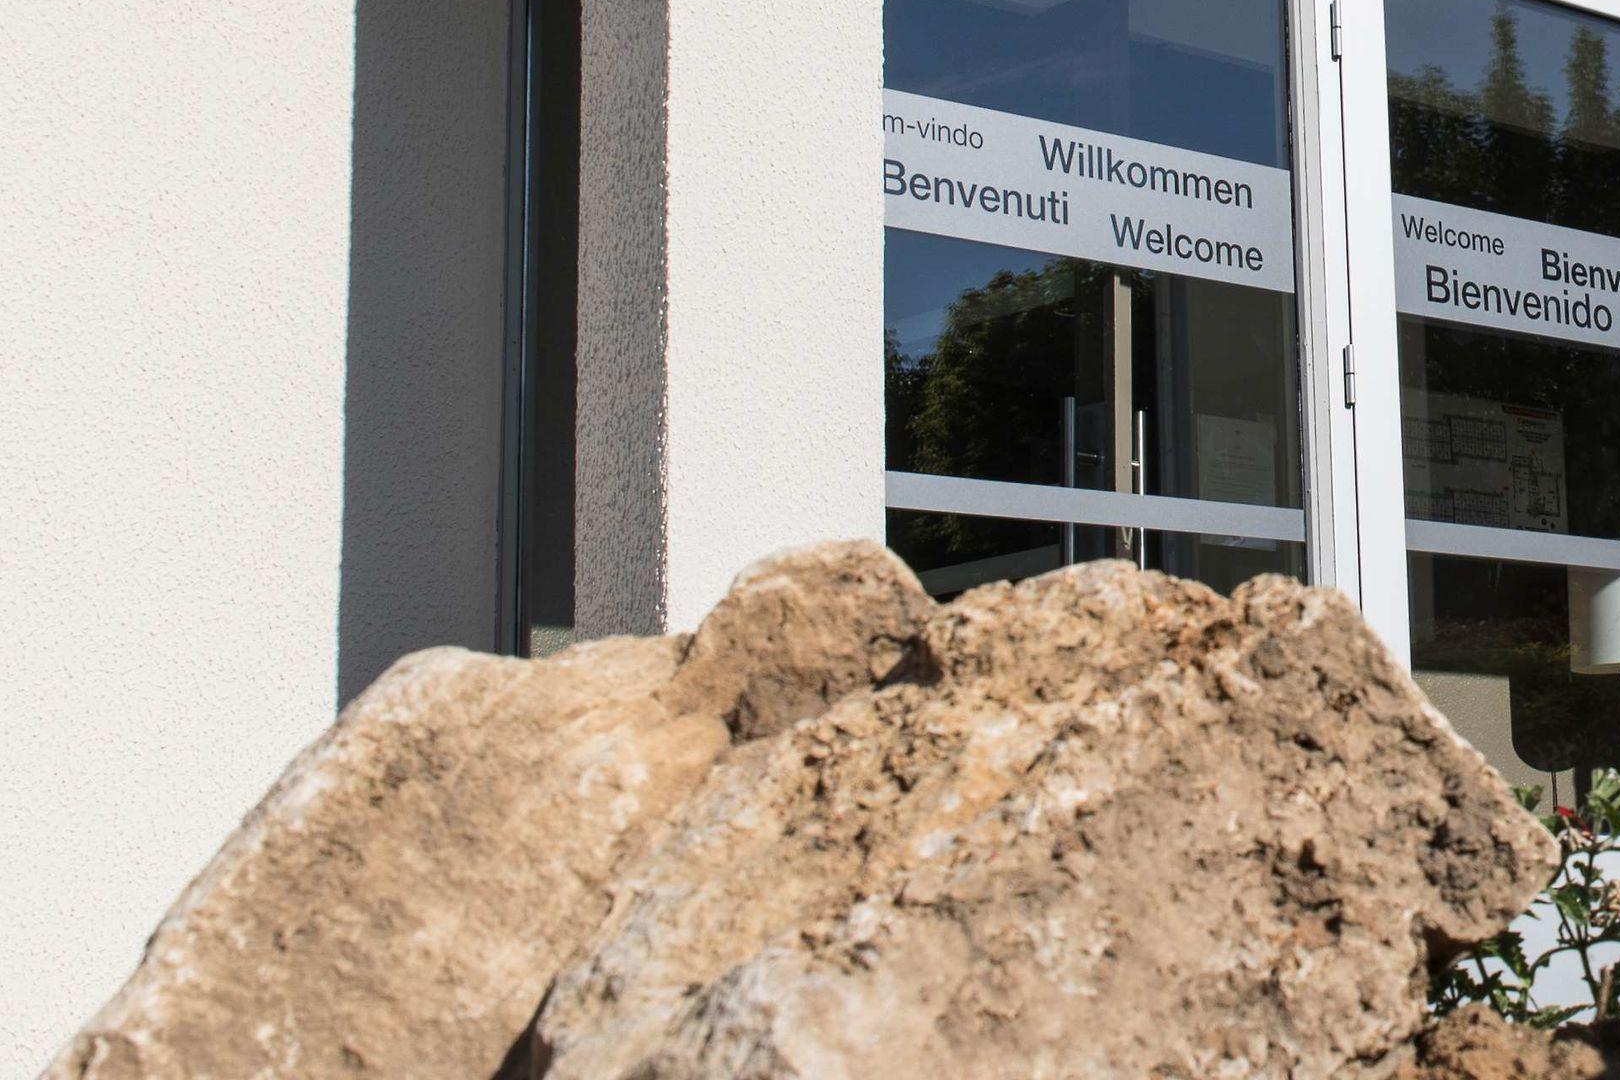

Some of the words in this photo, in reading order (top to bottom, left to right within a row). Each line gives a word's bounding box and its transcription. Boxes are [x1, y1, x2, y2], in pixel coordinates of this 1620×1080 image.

[882, 113, 984, 149] m-vindo
[883, 158, 1069, 226] Benvenuti
[1038, 133, 1254, 209] Willkommen
[1109, 212, 1264, 272] Welcome
[1400, 212, 1505, 256] Welcome
[1425, 263, 1613, 332] Bienvenido
